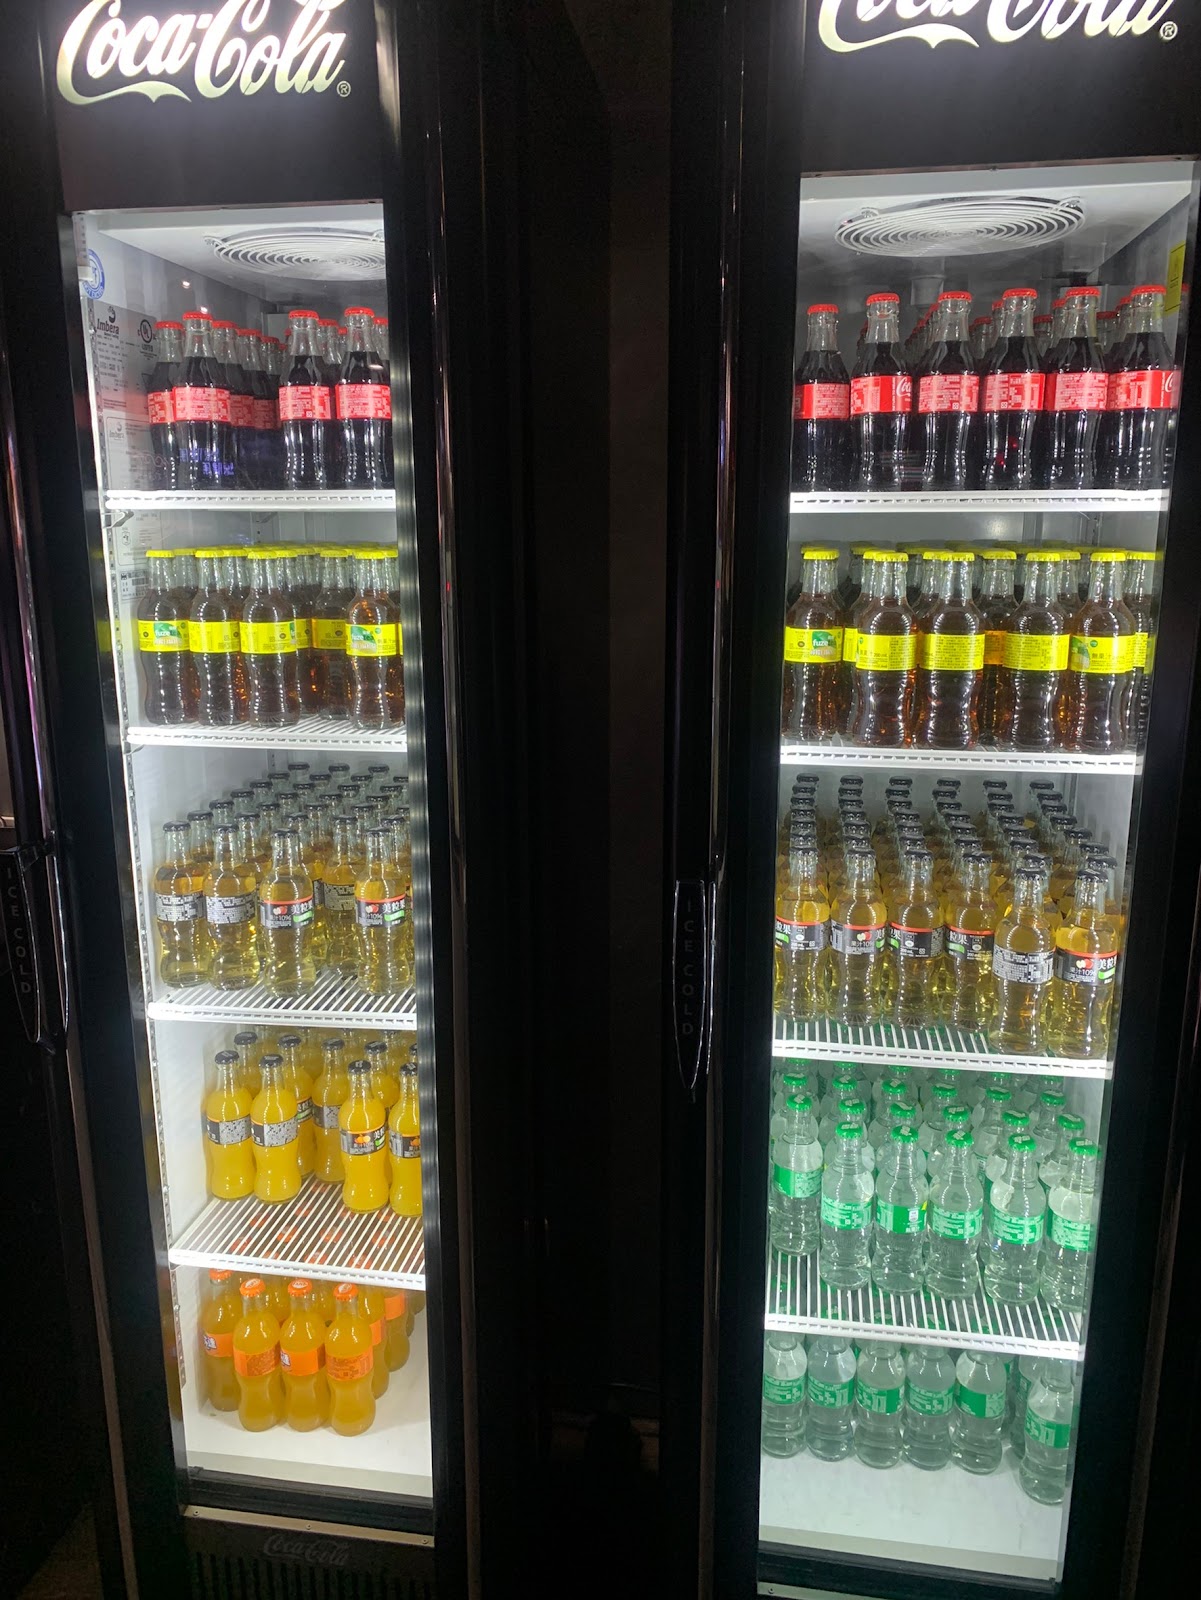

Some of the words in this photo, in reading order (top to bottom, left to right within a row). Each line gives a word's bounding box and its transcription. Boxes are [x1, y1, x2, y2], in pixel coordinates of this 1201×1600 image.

[97, 318, 120, 334] Imbera
[813, 639, 829, 647] fuze
[7, 868, 20, 916] ICE
[683, 900, 695, 953] ICE
[14, 928, 31, 992] COLD
[682, 963, 695, 1036] COLD
